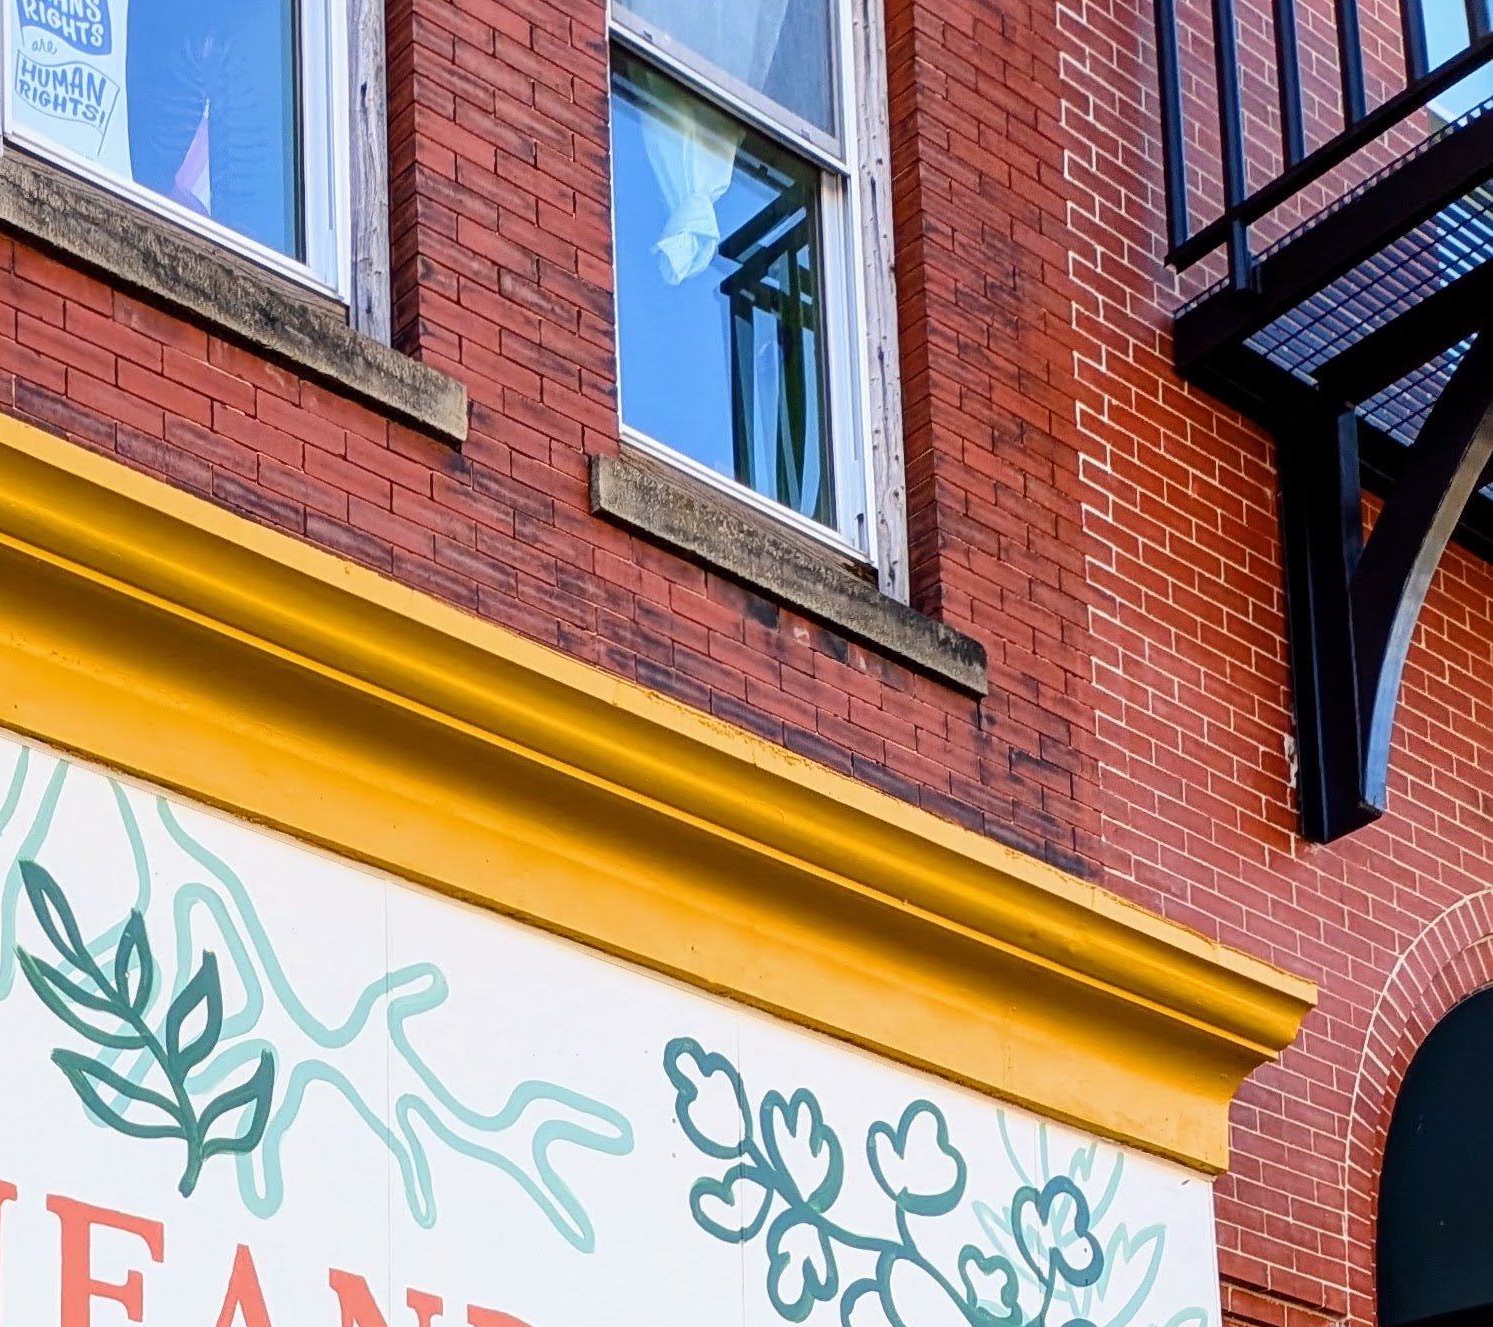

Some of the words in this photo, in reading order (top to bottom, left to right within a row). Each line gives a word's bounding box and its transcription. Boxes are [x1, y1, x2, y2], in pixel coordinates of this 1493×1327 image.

[23, 0, 105, 48] RIGHTS
[32, 38, 57, 55] are
[19, 78, 106, 128] RIGHTS!
[21, 58, 107, 107] HUMAN
